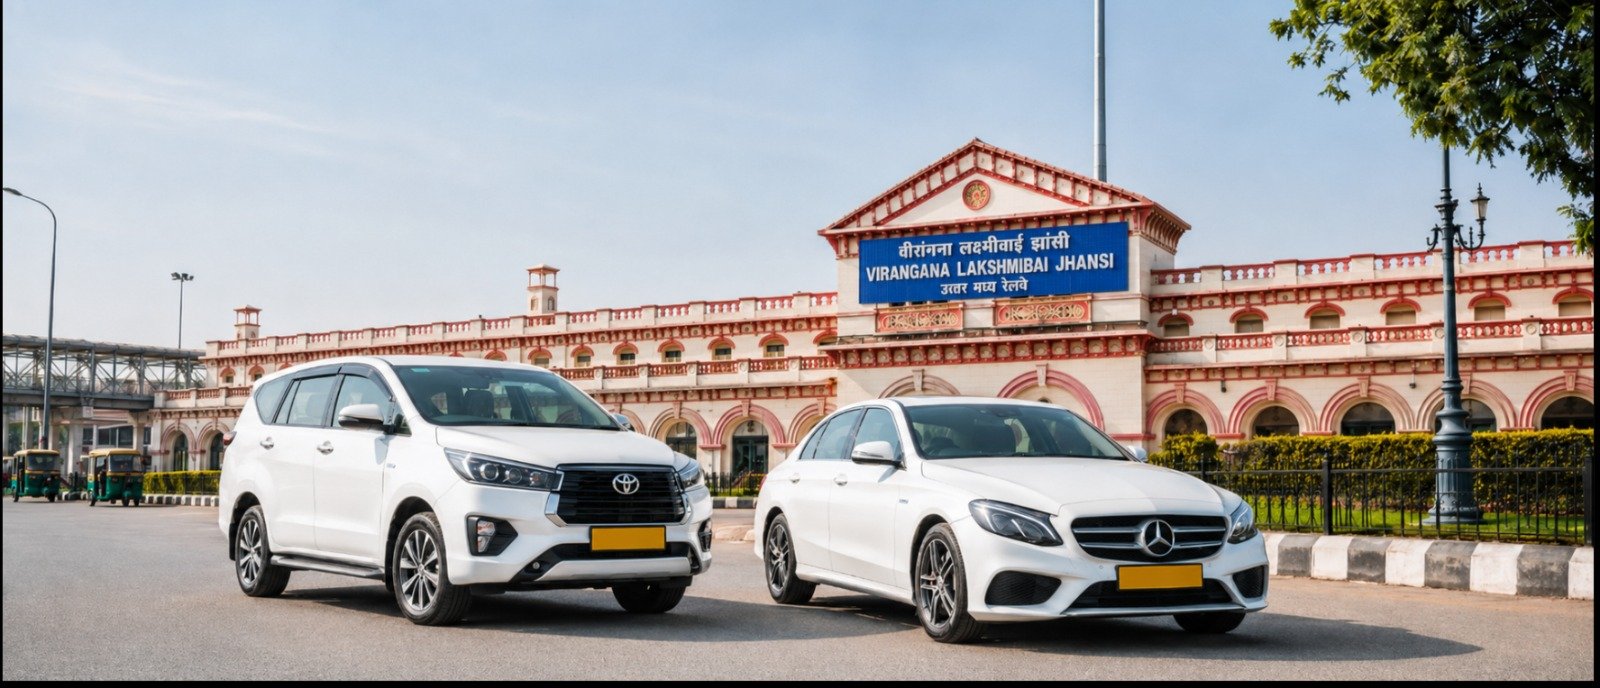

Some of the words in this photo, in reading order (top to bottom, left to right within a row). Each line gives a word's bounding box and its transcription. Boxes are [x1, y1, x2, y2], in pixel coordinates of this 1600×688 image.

[1030, 230, 1071, 252] झांसी
[866, 262, 951, 282] VIRANGANA
[957, 256, 1049, 277] LAKSHMIBAI
[1055, 252, 1114, 272] JHANSI
[1001, 276, 1029, 292] रेलवे
